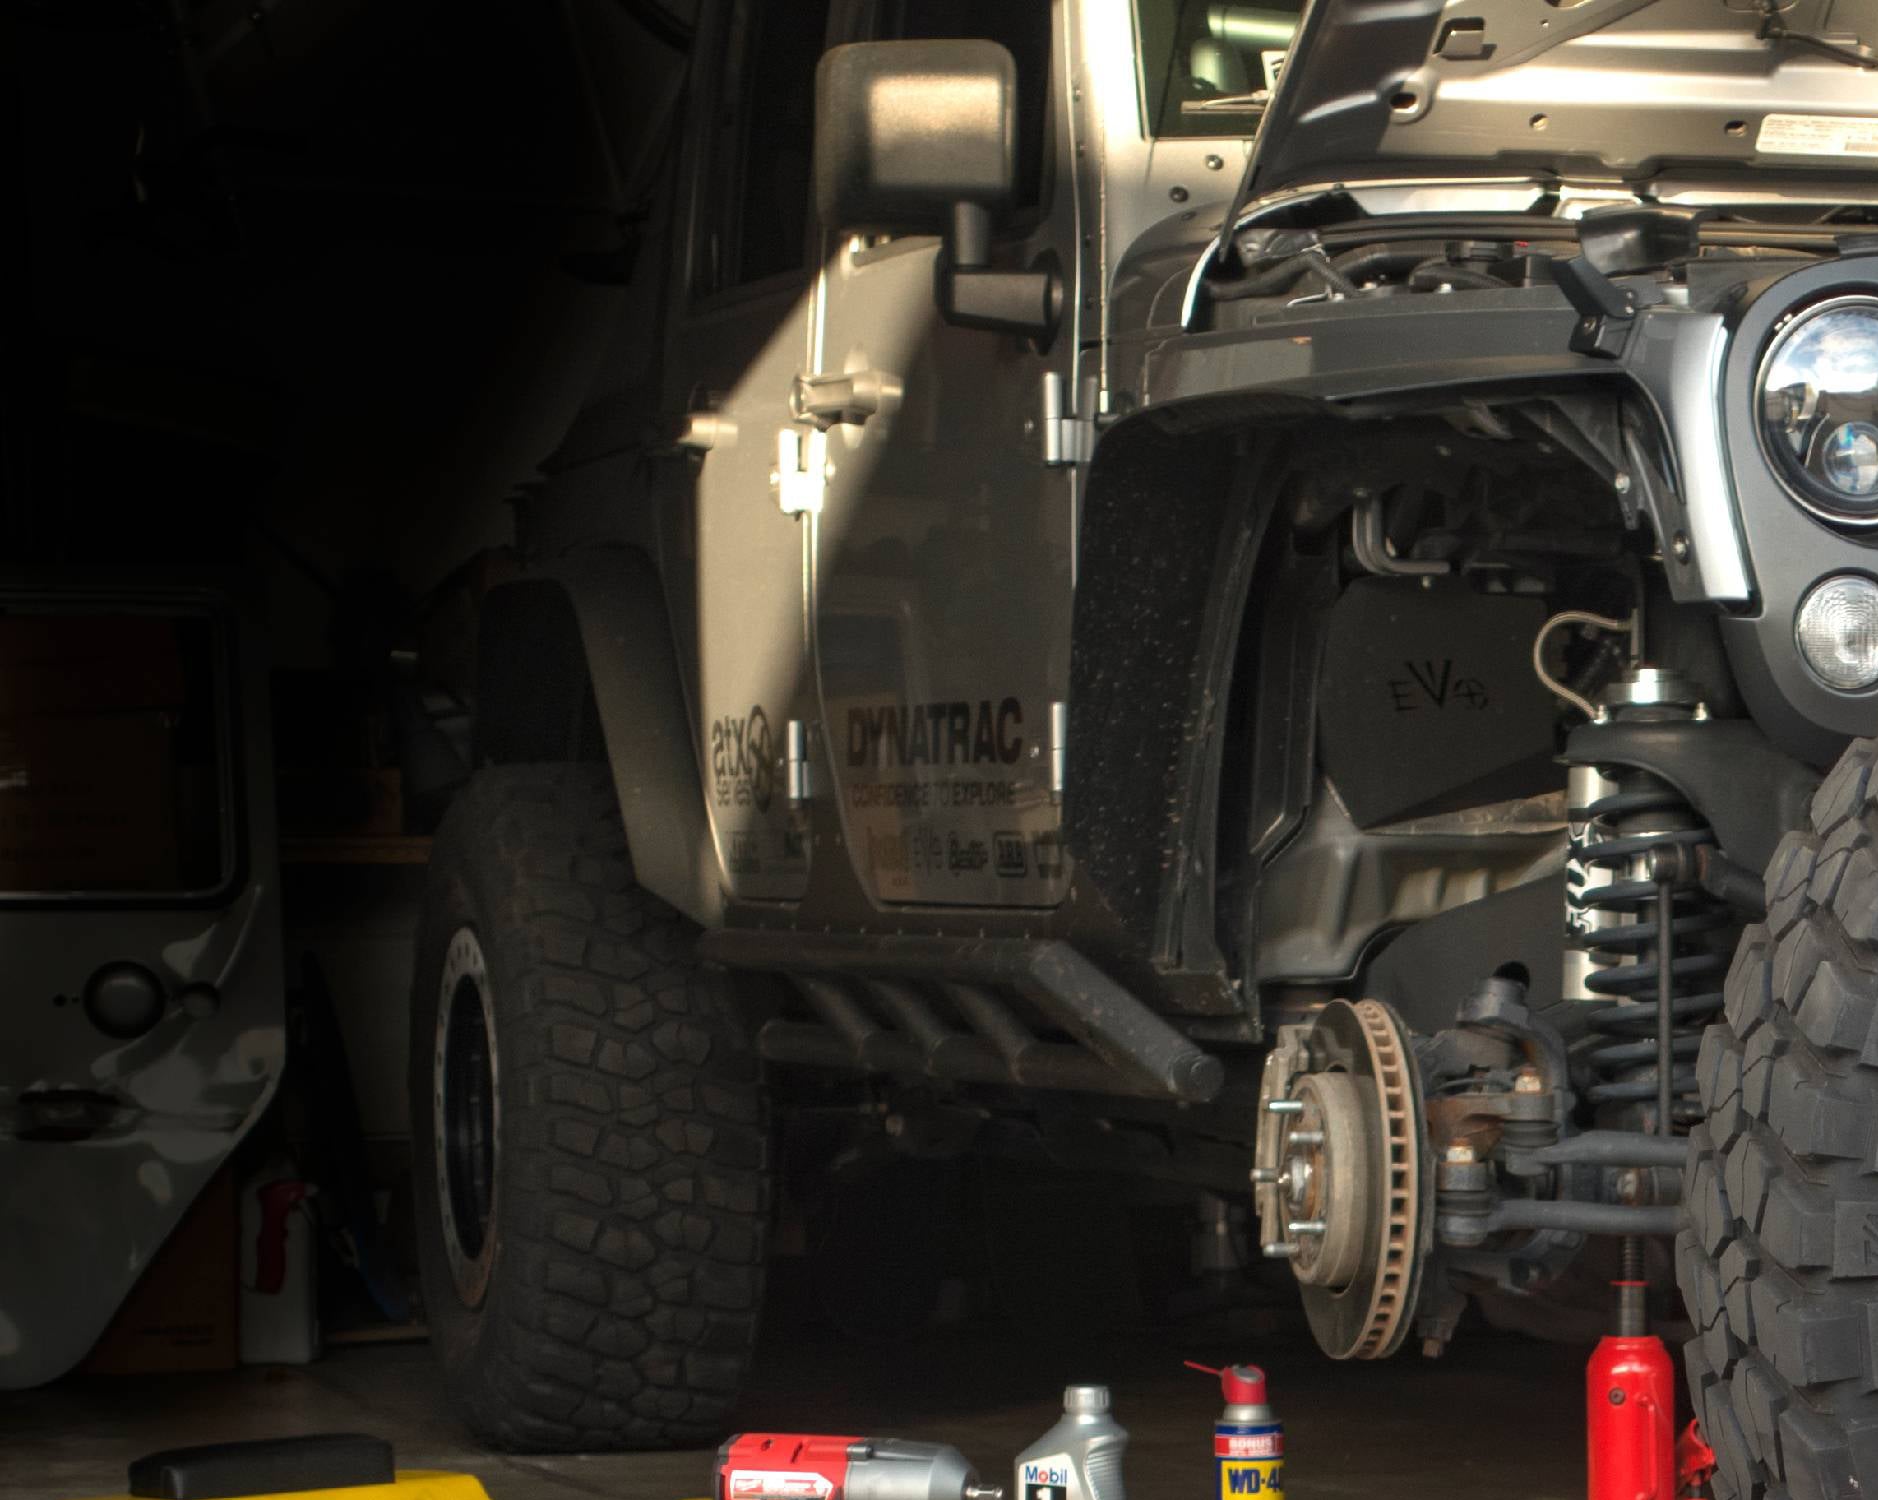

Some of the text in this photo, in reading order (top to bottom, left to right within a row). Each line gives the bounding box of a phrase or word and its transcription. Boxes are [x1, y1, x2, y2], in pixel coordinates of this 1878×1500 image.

[846, 697, 1022, 768] DYNATRAC
[1025, 1465, 1067, 1484] Mobil
[1228, 1466, 1281, 1494] WD-4
